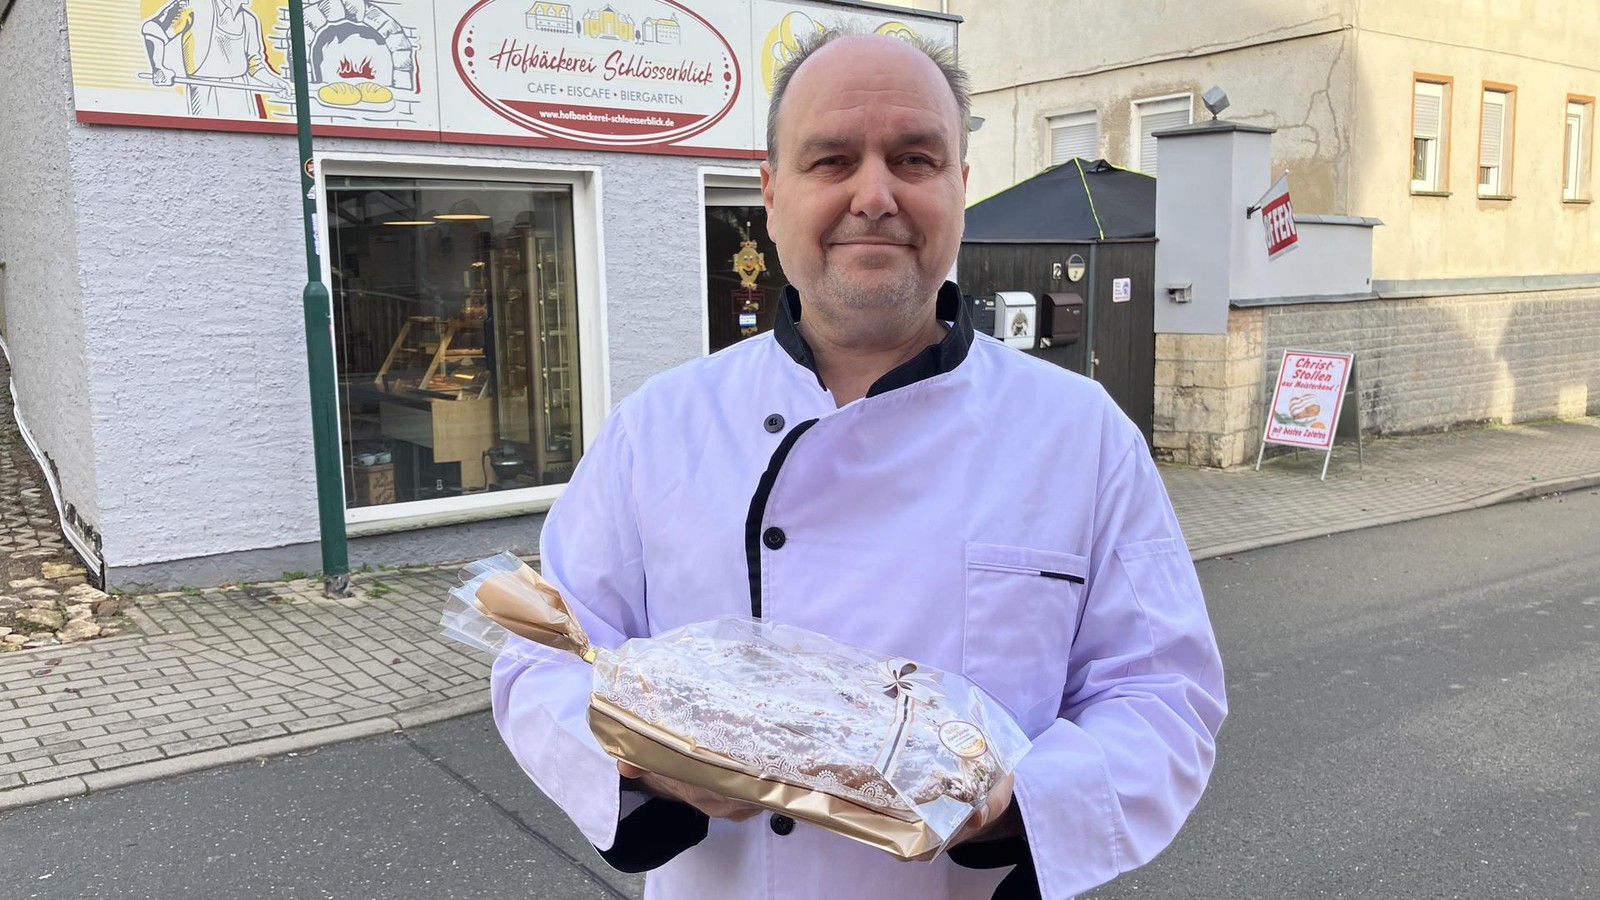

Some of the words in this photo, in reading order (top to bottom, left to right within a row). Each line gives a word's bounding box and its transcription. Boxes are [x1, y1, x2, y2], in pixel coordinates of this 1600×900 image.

[489, 38, 597, 74] Hofbäckerei
[603, 49, 714, 85] Schlösserblick
[527, 82, 557, 95] CAFE
[567, 85, 611, 99] EISCAFE
[620, 90, 684, 105] BIERGARTEN
[539, 109, 675, 127] www.hofbaeckerei-schloesserblick.de
[1262, 201, 1296, 249] OFFEN
[1295, 357, 1335, 370] Christ-
[1292, 369, 1332, 382] Stollen
[1272, 426, 1283, 434] mit
